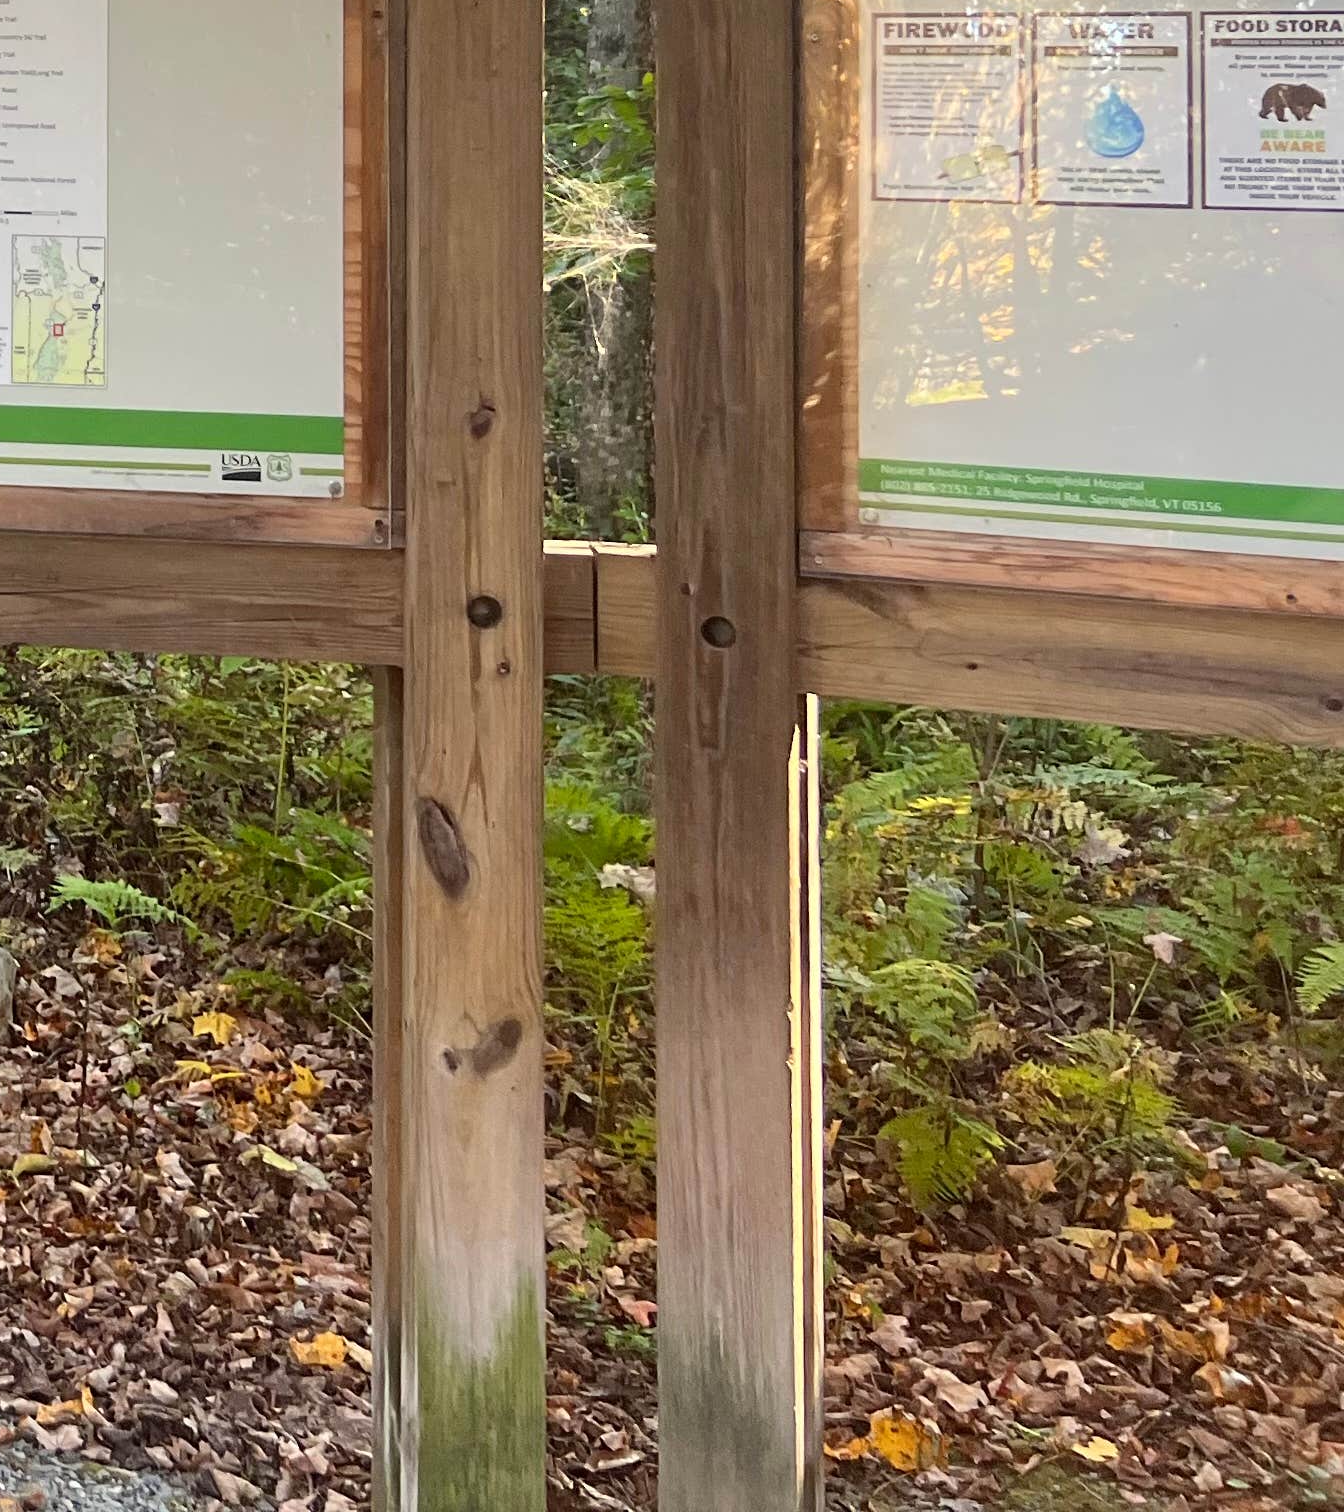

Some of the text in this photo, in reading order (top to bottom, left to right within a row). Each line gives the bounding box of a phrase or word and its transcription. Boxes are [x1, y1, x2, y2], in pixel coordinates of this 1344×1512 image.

[1068, 21, 1155, 40] WAER
[1214, 19, 1343, 34] FOOD STORA
[1259, 129, 1326, 139] BE BEAR
[1260, 141, 1326, 153] AWARE
[221, 453, 262, 467] USDA
[1024, 471, 1092, 489] Springfield
[1093, 477, 1145, 492] Hospital
